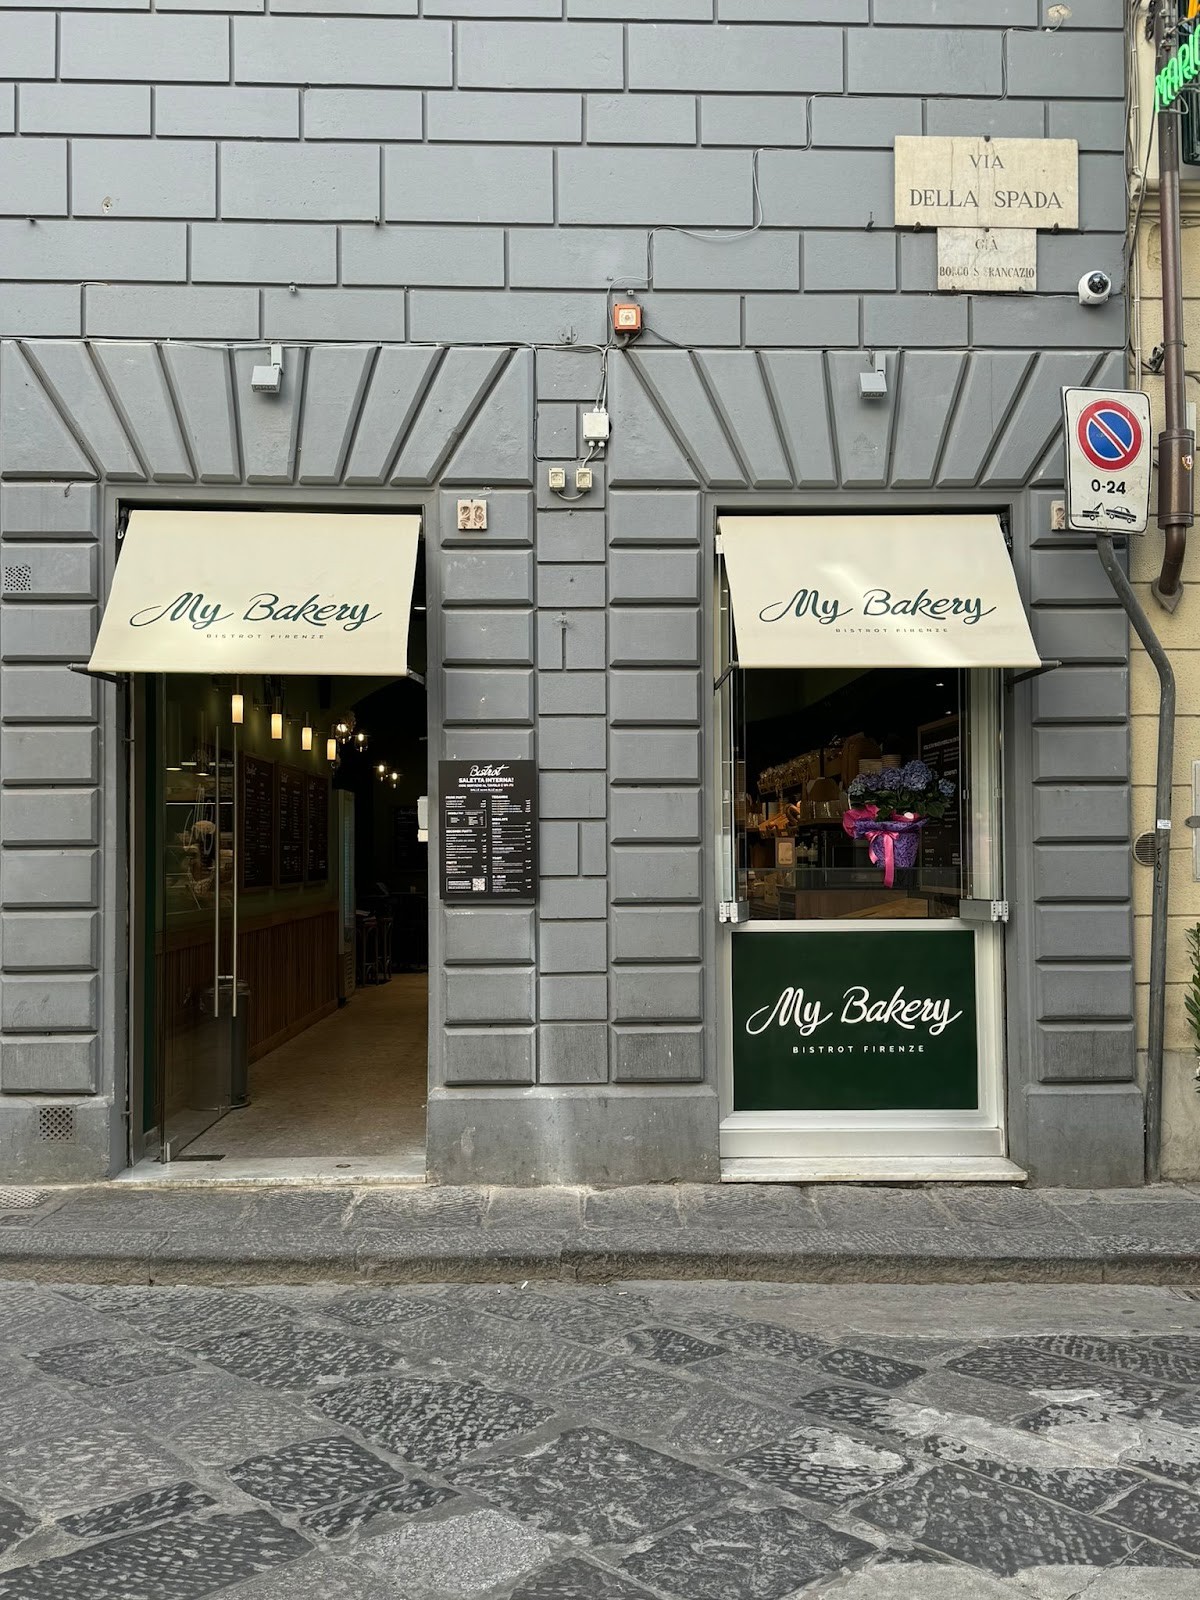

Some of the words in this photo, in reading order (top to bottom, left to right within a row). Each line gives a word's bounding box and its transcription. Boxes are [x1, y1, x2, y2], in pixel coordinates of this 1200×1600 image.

[969, 154, 1005, 169] VIA
[910, 188, 979, 208] DELLA
[994, 190, 1063, 209] SPADA
[1091, 478, 1127, 495] 0-24
[129, 592, 235, 630] My
[242, 592, 383, 632] Bakery
[758, 588, 854, 625] My
[863, 588, 997, 625] Bakery
[469, 763, 510, 777] Bistrot
[745, 986, 834, 1037] My
[840, 985, 963, 1036] Bakery
[792, 1045, 854, 1054] BISTROT
[863, 1044, 925, 1053] FIRENZE
